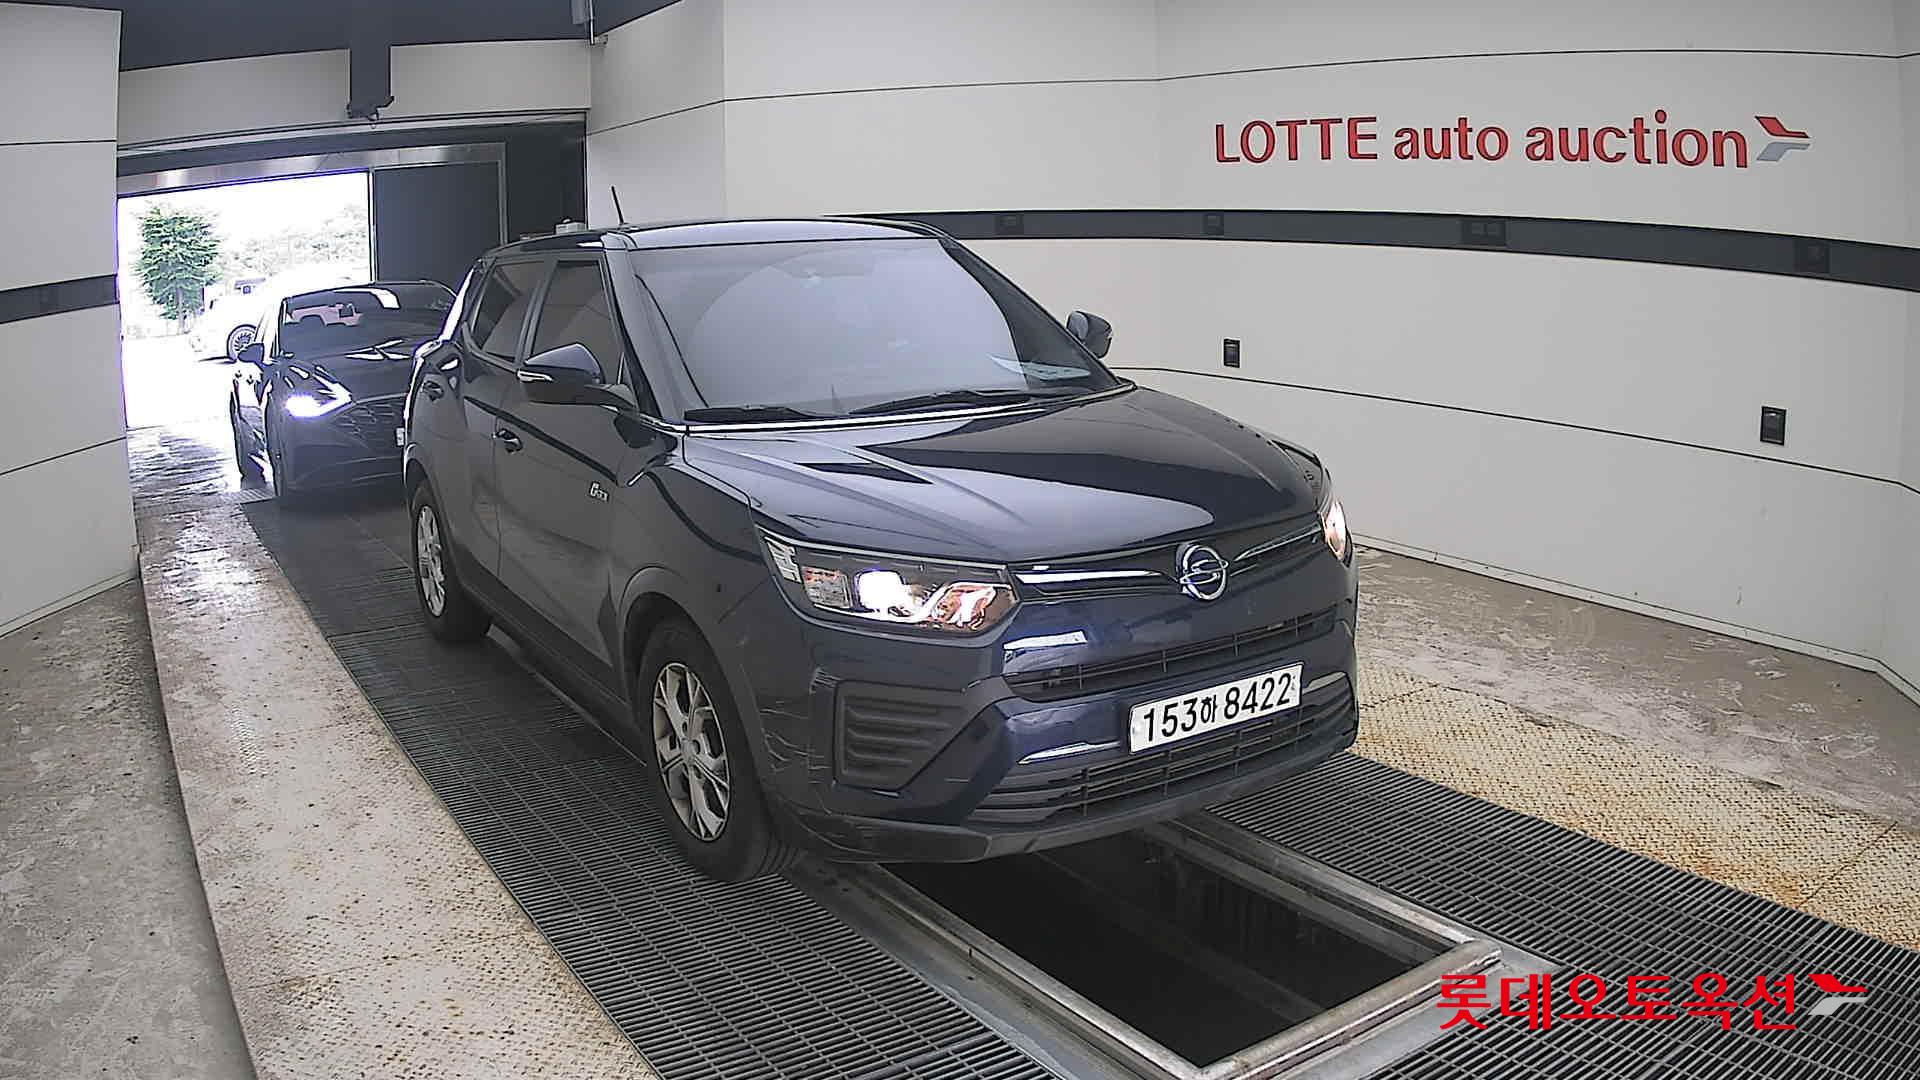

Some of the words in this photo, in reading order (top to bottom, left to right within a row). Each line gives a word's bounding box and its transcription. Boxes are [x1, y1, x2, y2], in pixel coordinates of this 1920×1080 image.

[1215, 116, 1379, 164] LOTTE
[1393, 116, 1509, 161] auto
[1525, 109, 1748, 169] auction
